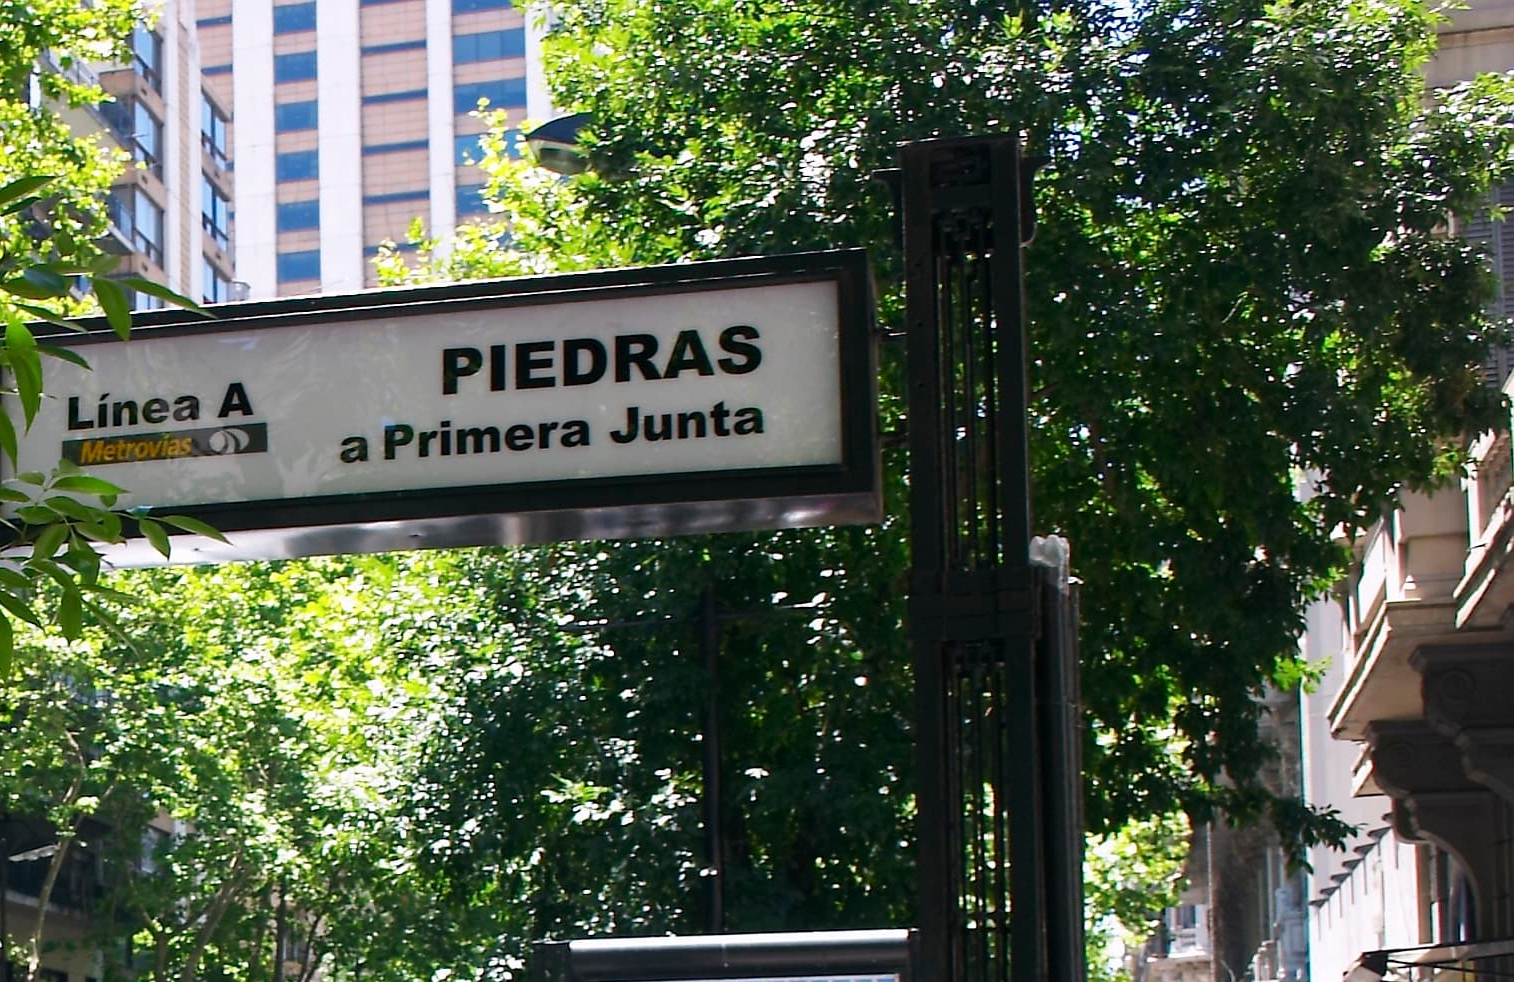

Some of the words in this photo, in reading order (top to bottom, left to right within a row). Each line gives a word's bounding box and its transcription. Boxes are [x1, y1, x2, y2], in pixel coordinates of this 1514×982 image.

[443, 325, 763, 396] PIEDRAS
[67, 393, 201, 431] Línea
[217, 382, 254, 417] A
[340, 433, 369, 463] a
[384, 415, 592, 461] Primera
[610, 400, 766, 445] Junta
[80, 432, 193, 464] Metrovías
